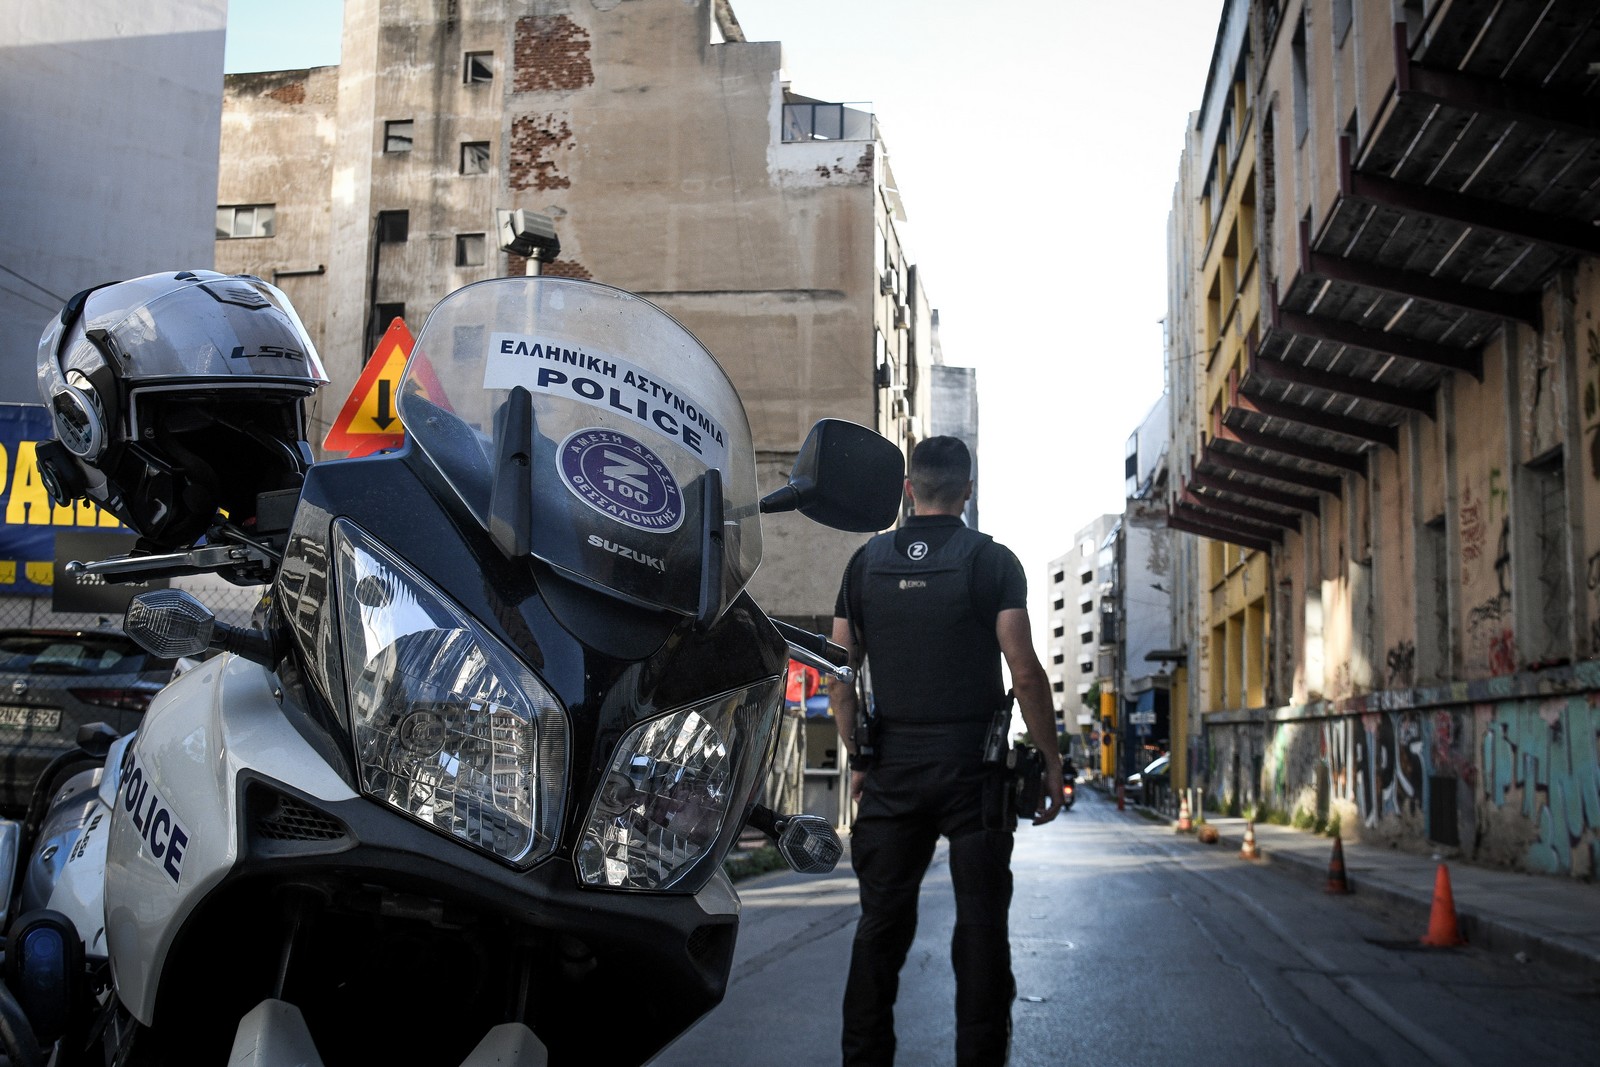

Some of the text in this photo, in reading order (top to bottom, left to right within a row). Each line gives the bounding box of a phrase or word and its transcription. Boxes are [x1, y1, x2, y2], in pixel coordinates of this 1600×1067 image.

[231, 345, 304, 362] LS2
[500, 339, 724, 448] ΕΛΛΗΝΙΚΗ ΑΣΤΥΝΟΜΙΑ
[537, 367, 703, 456] POLICE
[570, 433, 676, 495] ΑΜΕΣΗ ΔΡΑΣΗ
[602, 479, 649, 505] 100
[572, 475, 677, 526] ΘΕΣΣΑΛΟΝΙΚΗΣ
[587, 534, 666, 572] SUZUKI
[123, 754, 188, 884] POLICE
